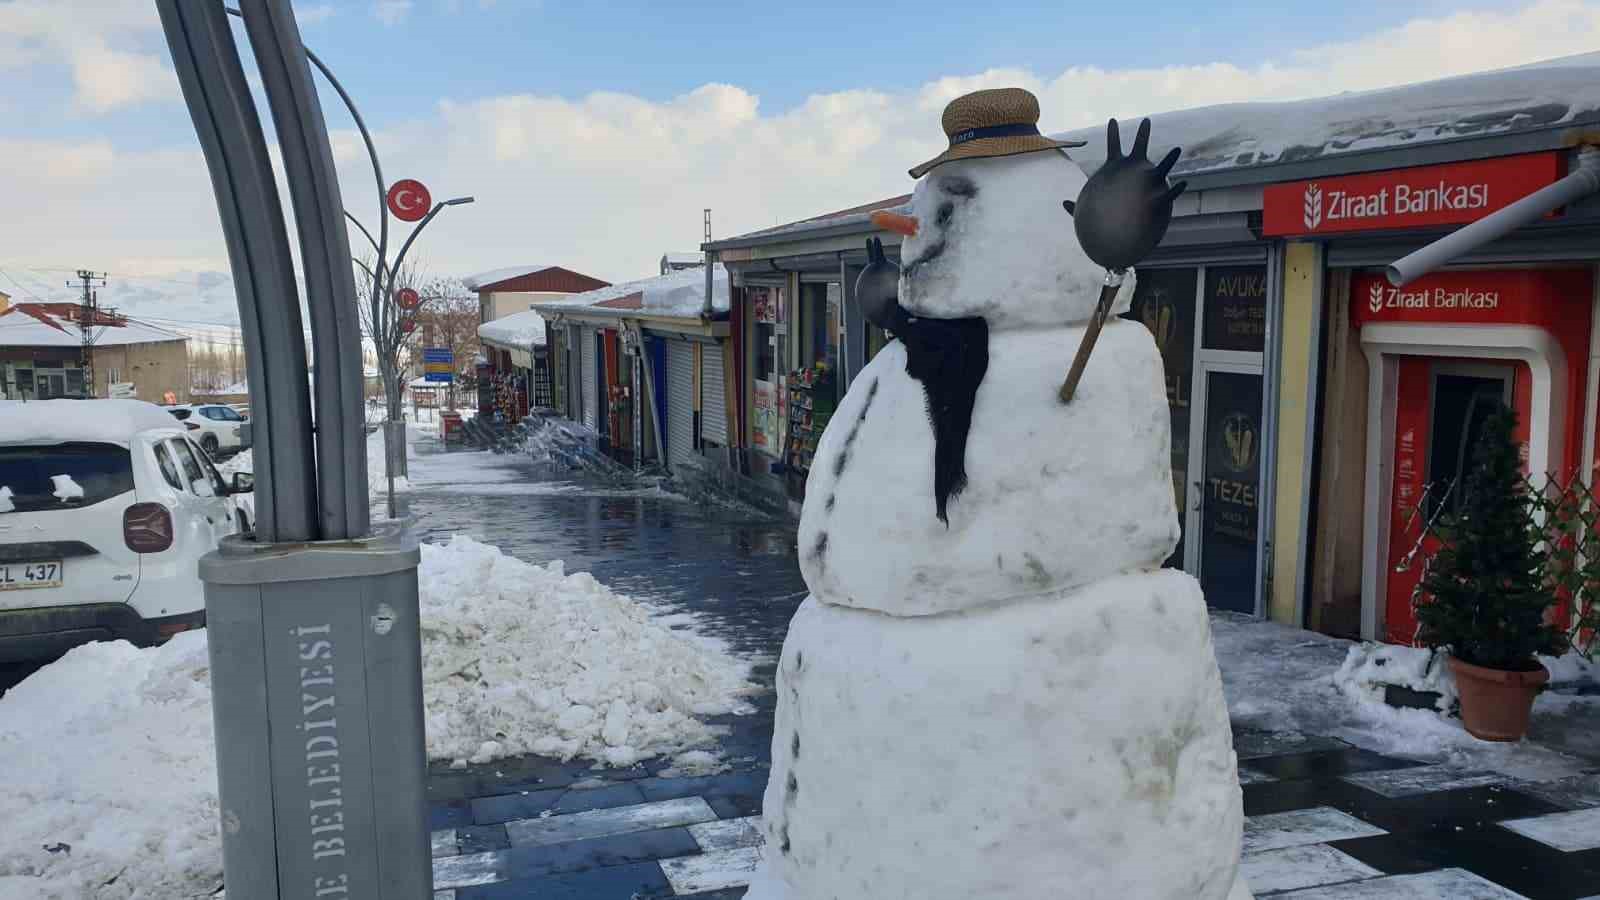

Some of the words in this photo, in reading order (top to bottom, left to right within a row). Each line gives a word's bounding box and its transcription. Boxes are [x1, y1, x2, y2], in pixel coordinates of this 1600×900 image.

[1327, 187, 1389, 219] Ziraat
[1394, 181, 1488, 214] Bankası
[1386, 288, 1430, 308] Ziraat
[1434, 288, 1499, 308] Bankası
[25, 564, 57, 581] 437
[289, 624, 346, 860] BELEDİYESİ
